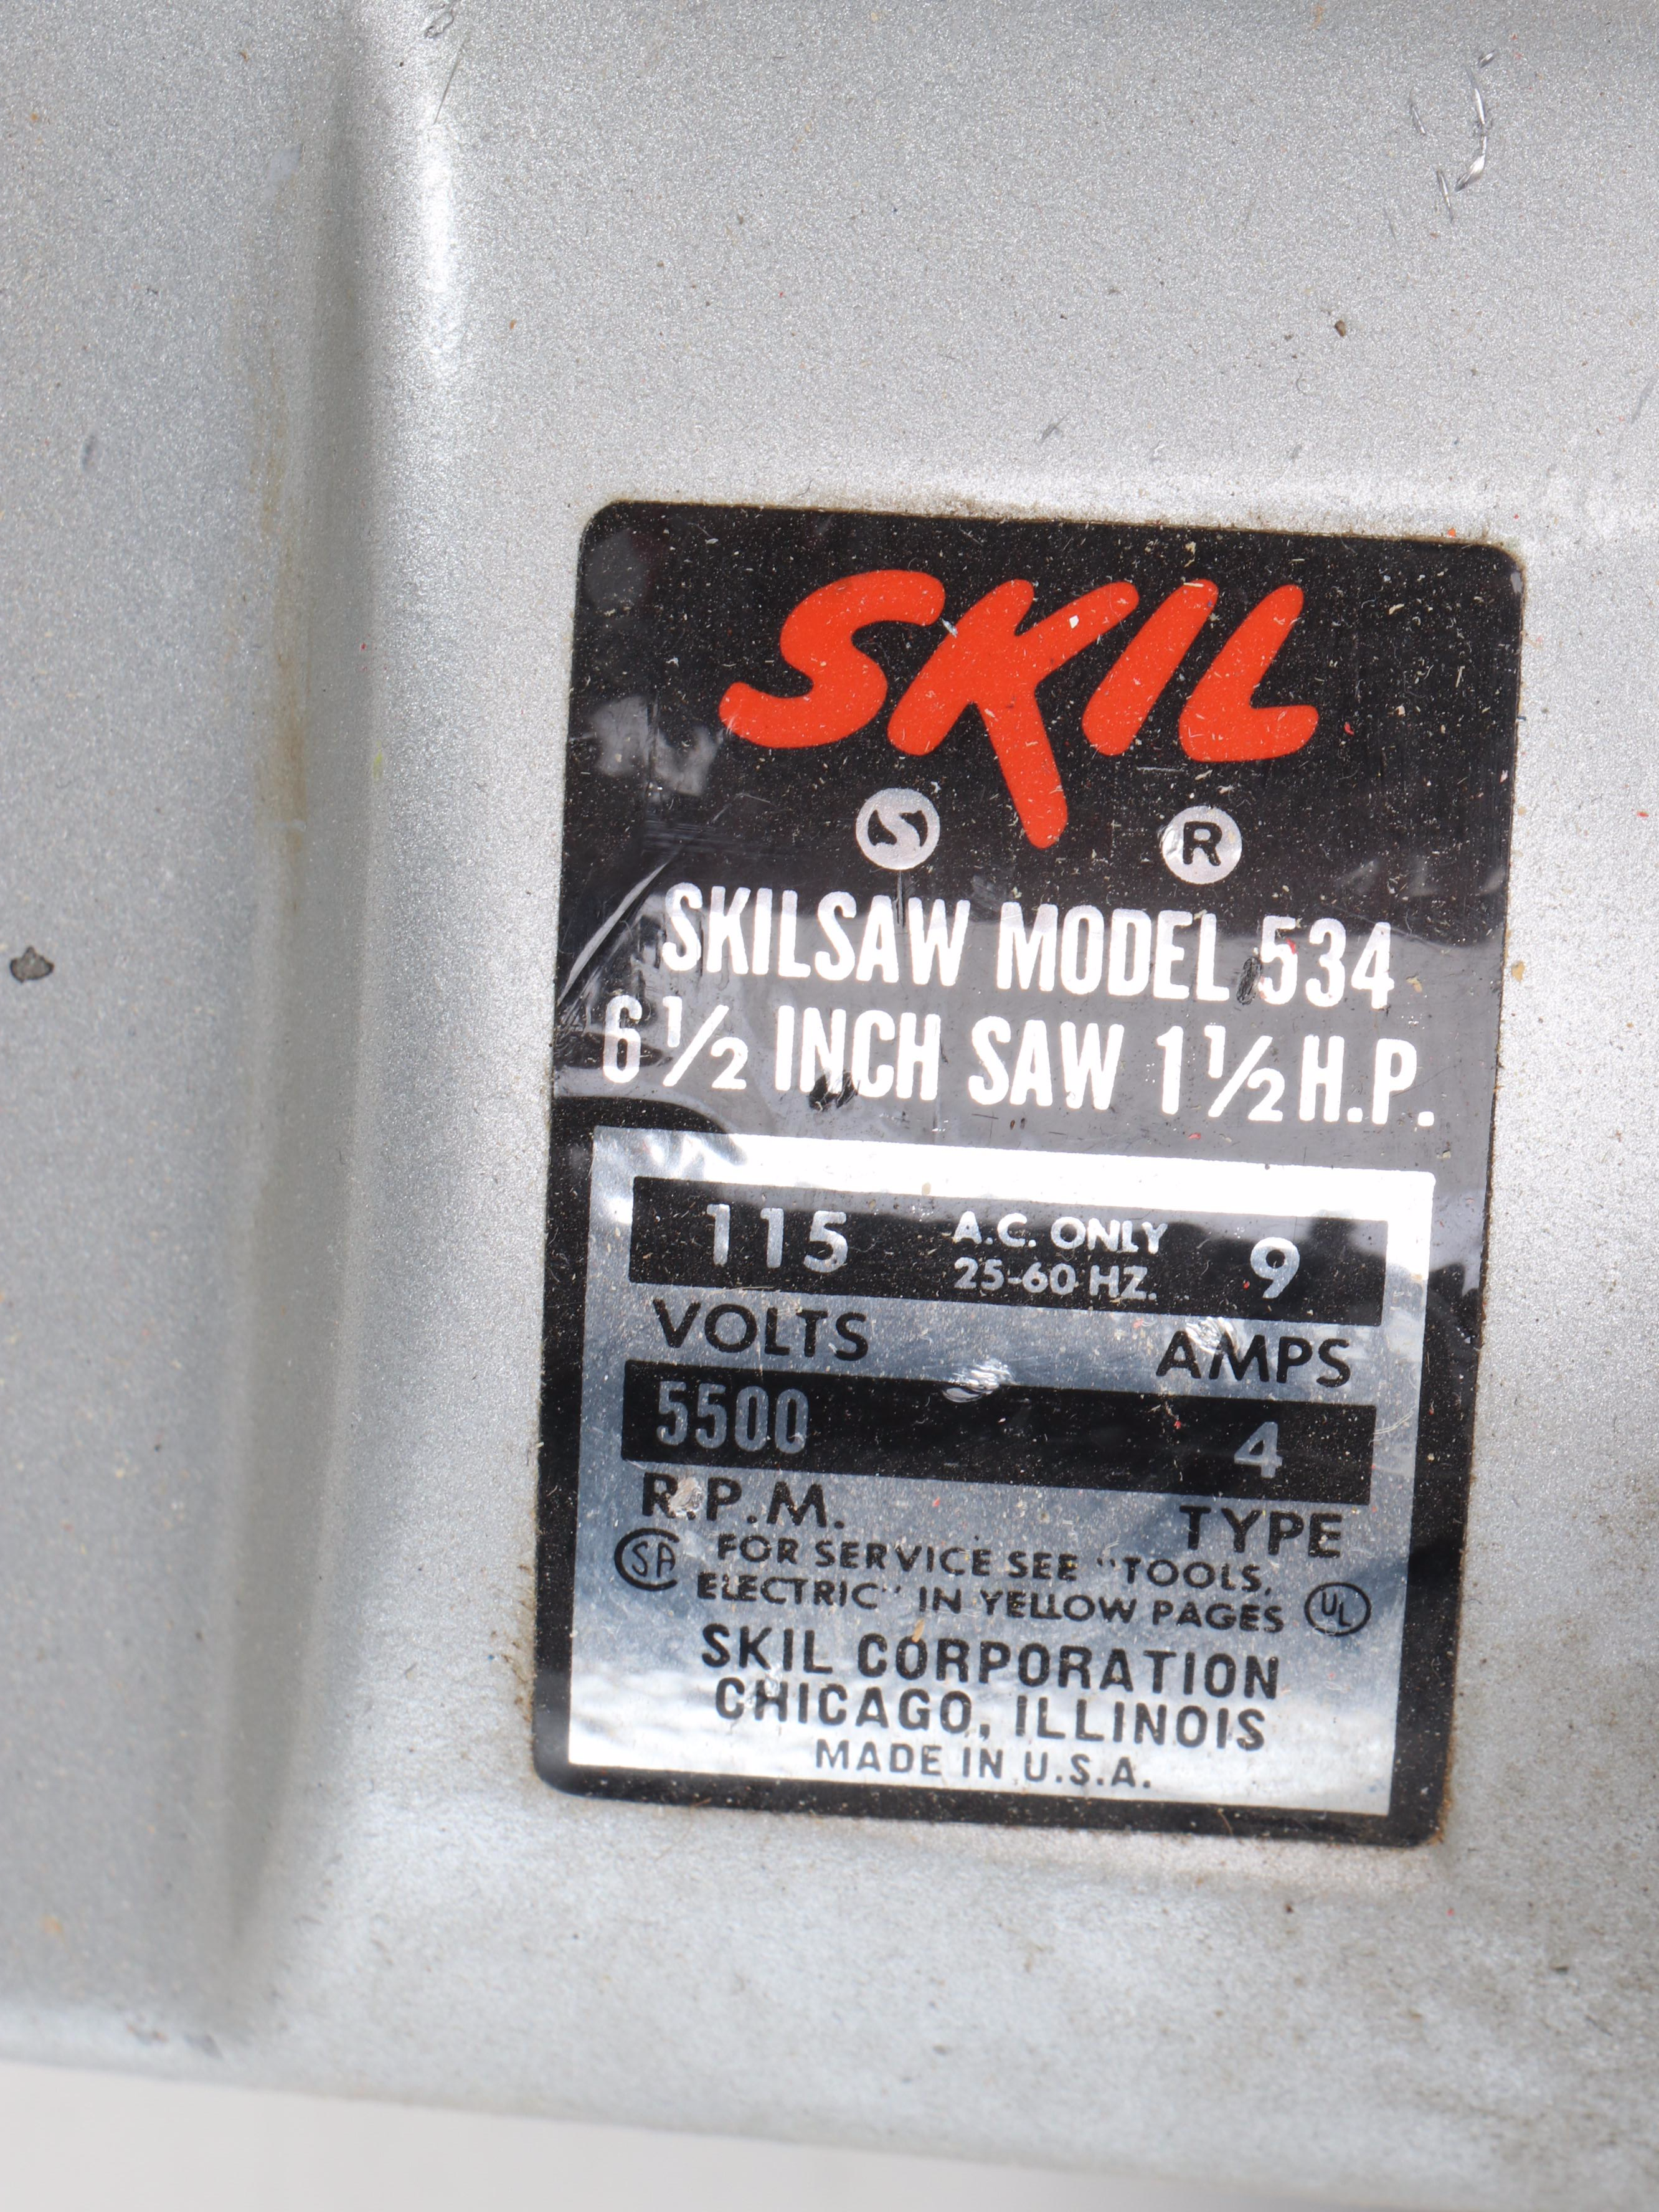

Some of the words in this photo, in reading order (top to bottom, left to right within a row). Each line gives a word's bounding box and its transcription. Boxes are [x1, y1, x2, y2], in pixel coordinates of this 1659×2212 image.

[718, 569, 1319, 848] SKIL
[661, 882, 970, 986] SKILSAW
[996, 901, 1229, 1001] MODEL
[1257, 915, 1394, 1009] 534
[775, 1004, 941, 1101] INCH
[968, 1016, 1124, 1111] SAW
[706, 1203, 847, 1273] 115
[953, 1211, 1036, 1247] A.C.
[1051, 1216, 1168, 1254] ONLY
[953, 1257, 1077, 1296] 25-60
[1250, 1237, 1300, 1299] 9
[653, 1298, 869, 1361] VOLTS
[1155, 1329, 1351, 1388] AMPS
[656, 1380, 808, 1455] 5500
[1233, 1421, 1283, 1480] 4
[641, 1472, 846, 1529] R.P.M.
[717, 1533, 799, 1564] FOR
[815, 1539, 991, 1577] SERVICE
[1008, 1551, 1078, 1582] SEE
[1179, 1505, 1343, 1558] TYPE
[918, 1585, 962, 1614] IN
[979, 1588, 1138, 1624] YELLOW
[1151, 1599, 1285, 1633] PAGES
[701, 1623, 834, 1675] SKIL
[857, 1633, 1280, 1700] CORPORATION
[715, 1676, 991, 1742] CHICAGO,
[1015, 1694, 1265, 1751] ILLINOIS
[816, 1739, 942, 1776] MADE
[962, 1746, 1004, 1779] IN
[1024, 1751, 1152, 1789] U.S.A.
